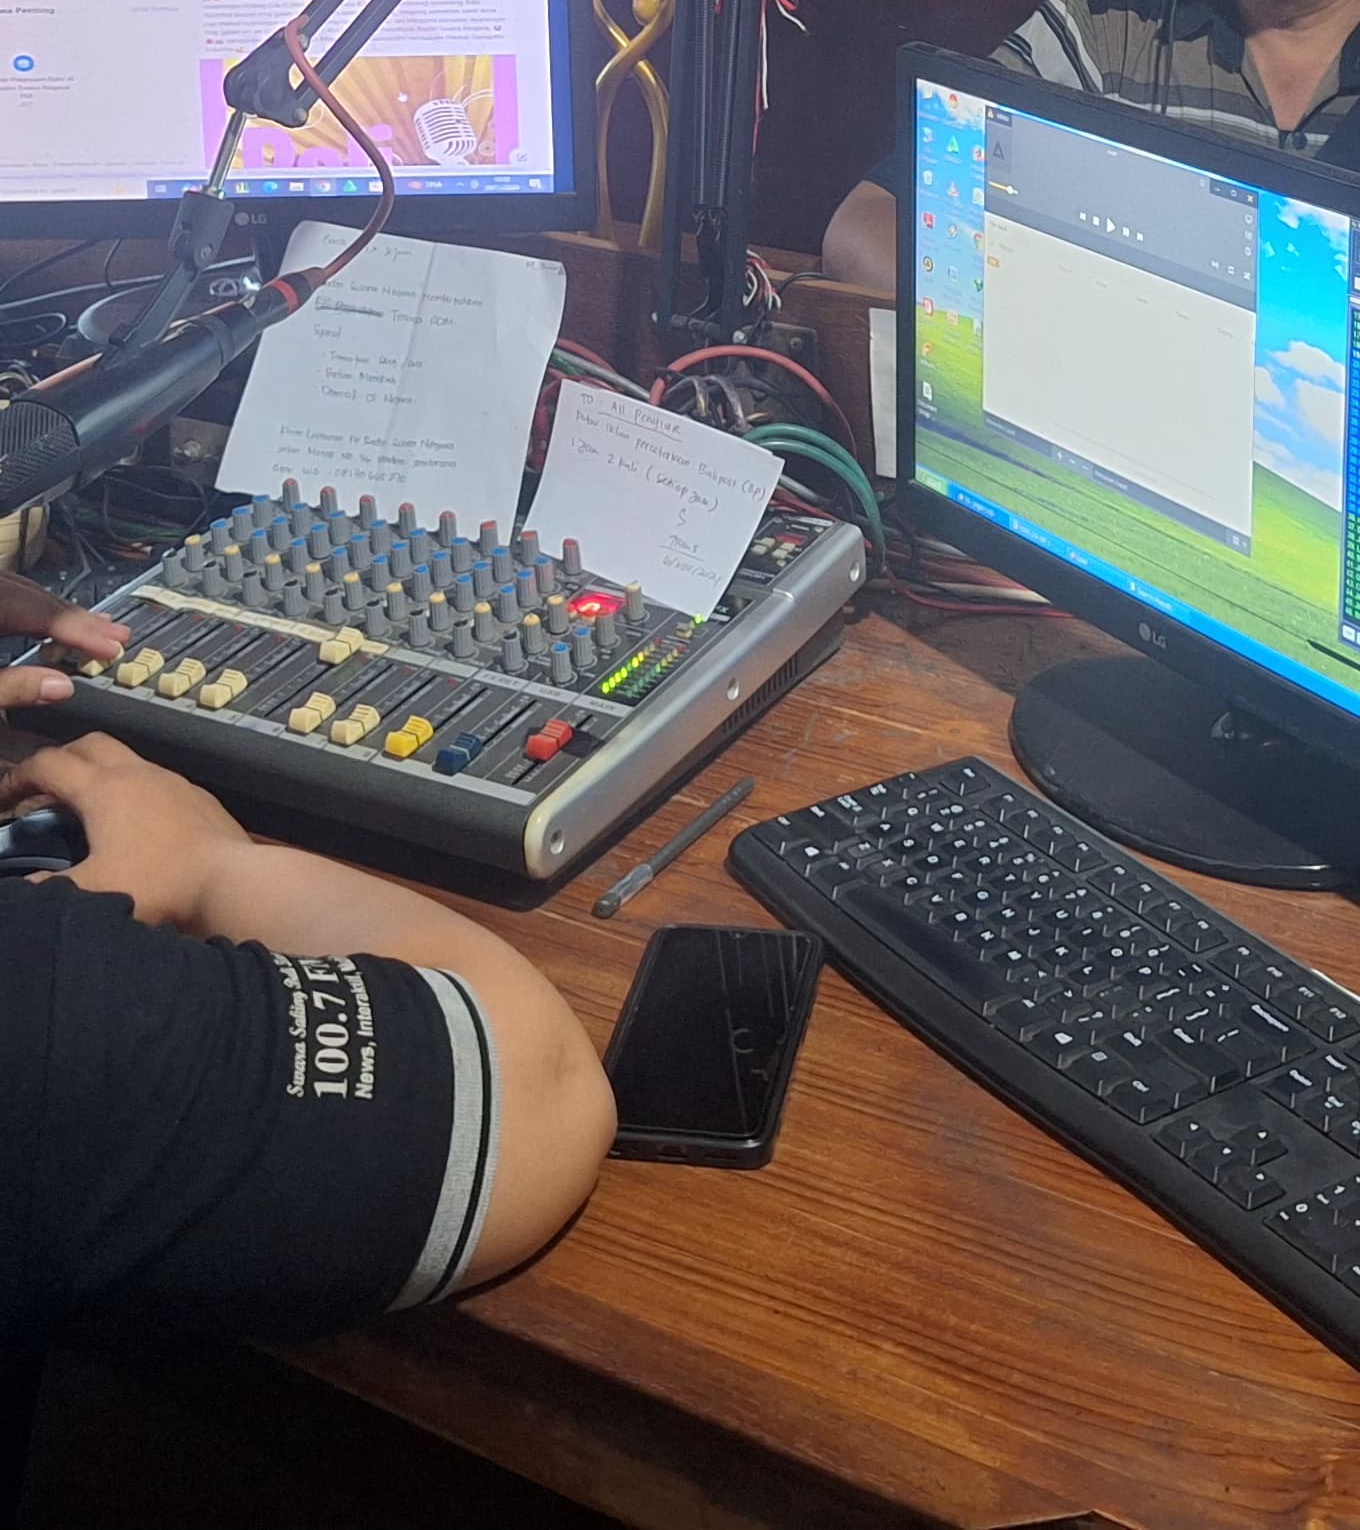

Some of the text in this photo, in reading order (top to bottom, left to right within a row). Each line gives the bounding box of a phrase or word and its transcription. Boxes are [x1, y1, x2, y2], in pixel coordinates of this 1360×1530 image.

[611, 400, 625, 416] All
[1152, 632, 1166, 650] LG
[287, 1041, 306, 1098] Swara
[313, 990, 349, 1099] 100.7
[354, 1041, 377, 1099] News,
